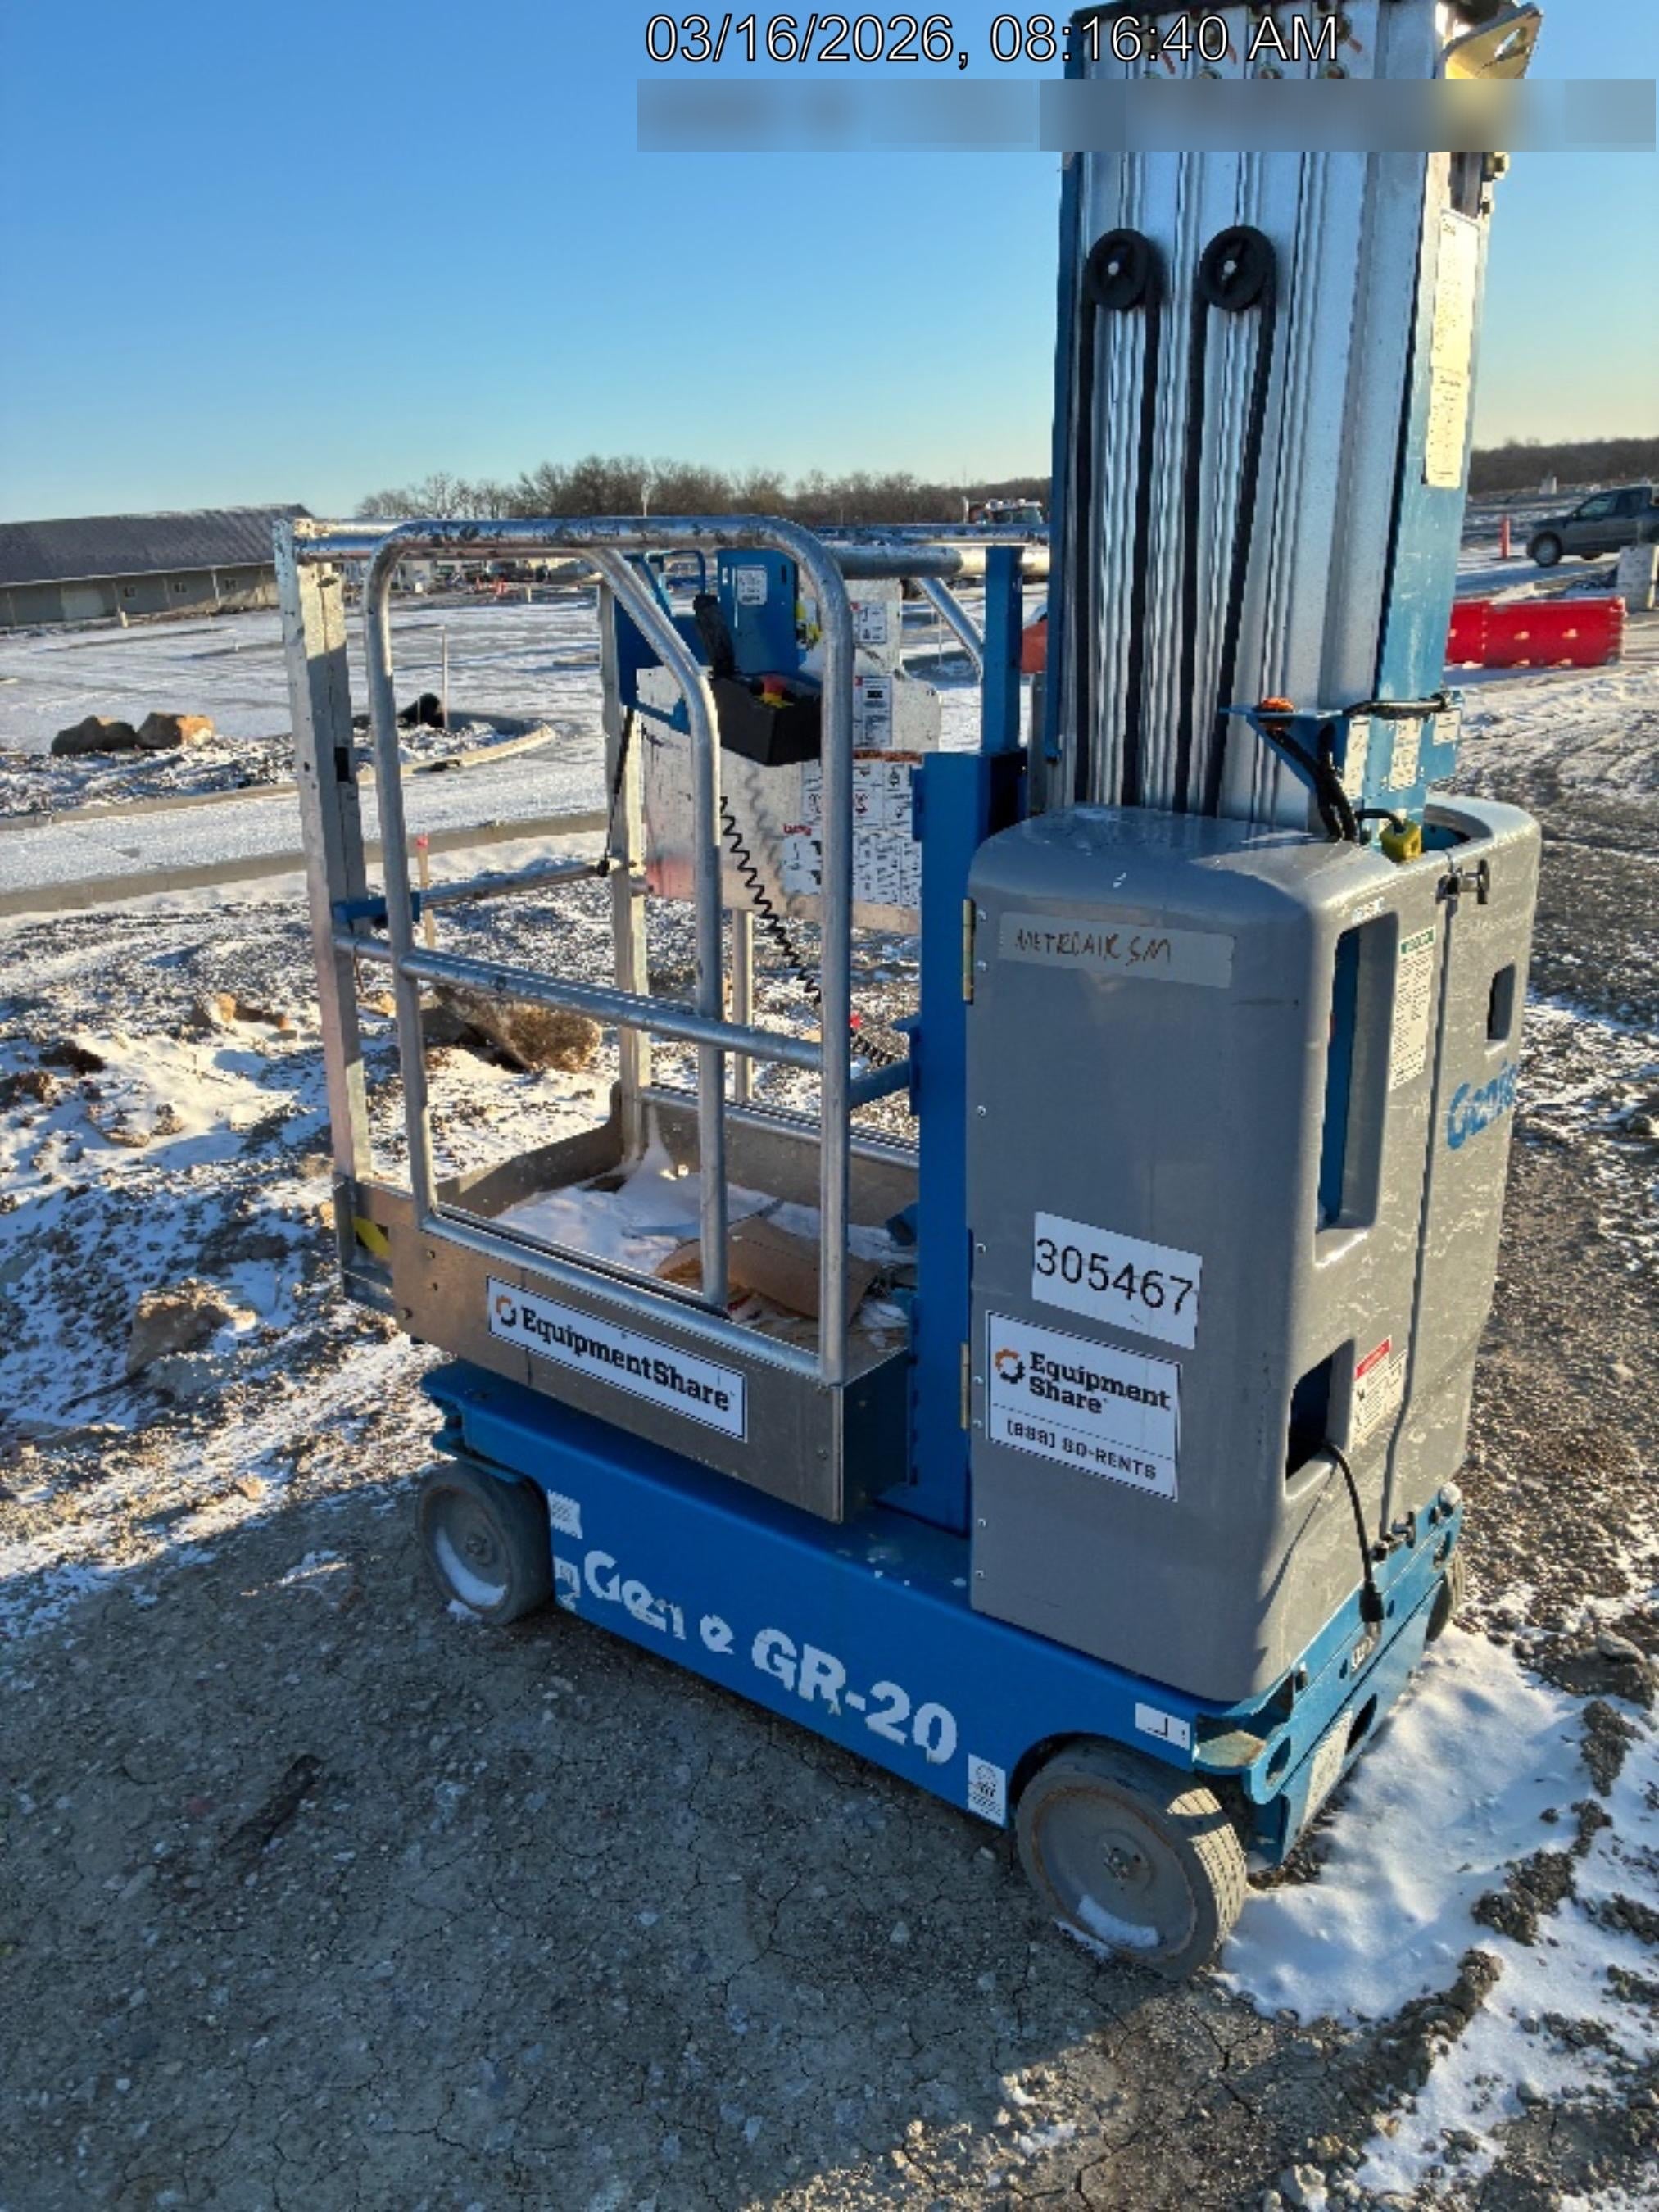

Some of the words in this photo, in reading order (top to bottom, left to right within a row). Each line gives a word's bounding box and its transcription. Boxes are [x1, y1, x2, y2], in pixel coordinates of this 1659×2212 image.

[1036, 1238, 1194, 1315] 305467
[521, 1304, 730, 1411] EquipmentShare
[1029, 1352, 1171, 1411] Equipment
[1029, 1376, 1103, 1414] Share
[751, 1629, 958, 1764] GR-20
